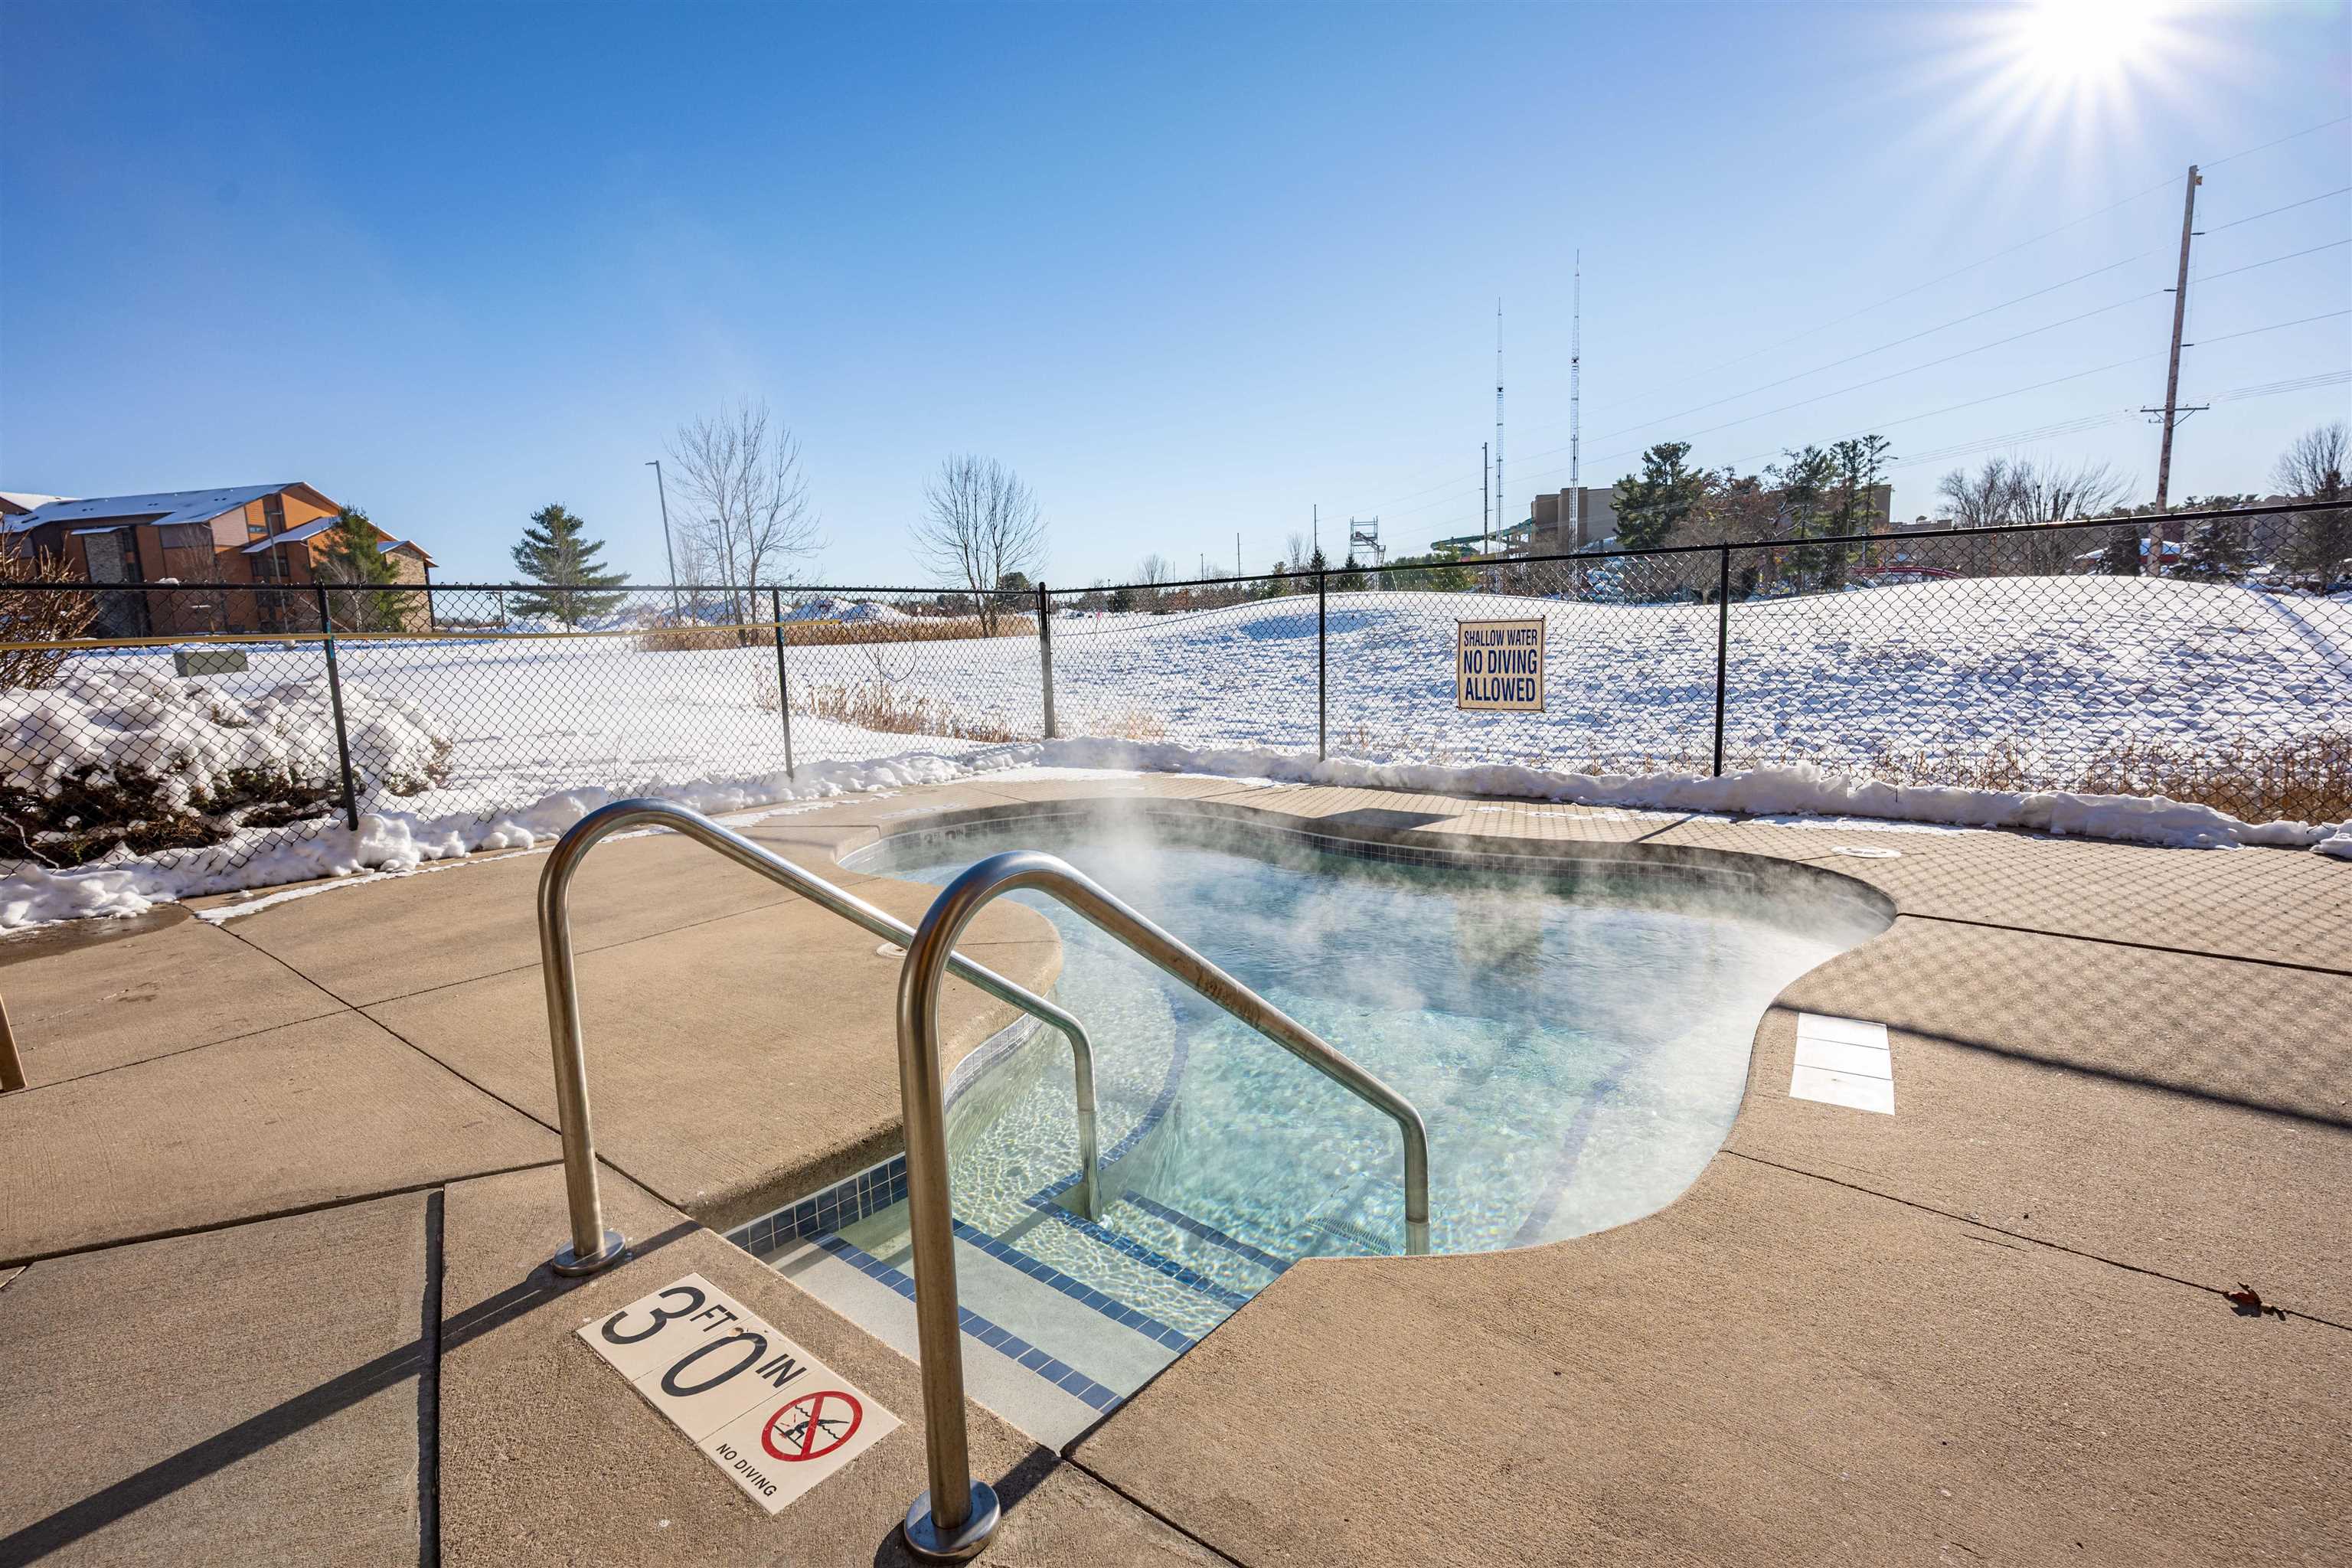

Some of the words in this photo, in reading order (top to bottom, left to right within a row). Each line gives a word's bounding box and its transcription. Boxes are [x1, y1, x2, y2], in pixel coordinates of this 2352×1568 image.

[1464, 629, 1504, 646] SHALLOW
[1508, 629, 1537, 645] WATER
[1464, 649, 1483, 675] NO
[1488, 648, 1537, 675] DIVING
[1465, 677, 1536, 702] ALLOWED
[601, 1285, 706, 1345] 3
[689, 1303, 741, 1332] FT
[660, 1330, 768, 1397] 0
[755, 1353, 808, 1389] IN
[716, 1443, 737, 1460] NO
[733, 1459, 777, 1497] DIVING
